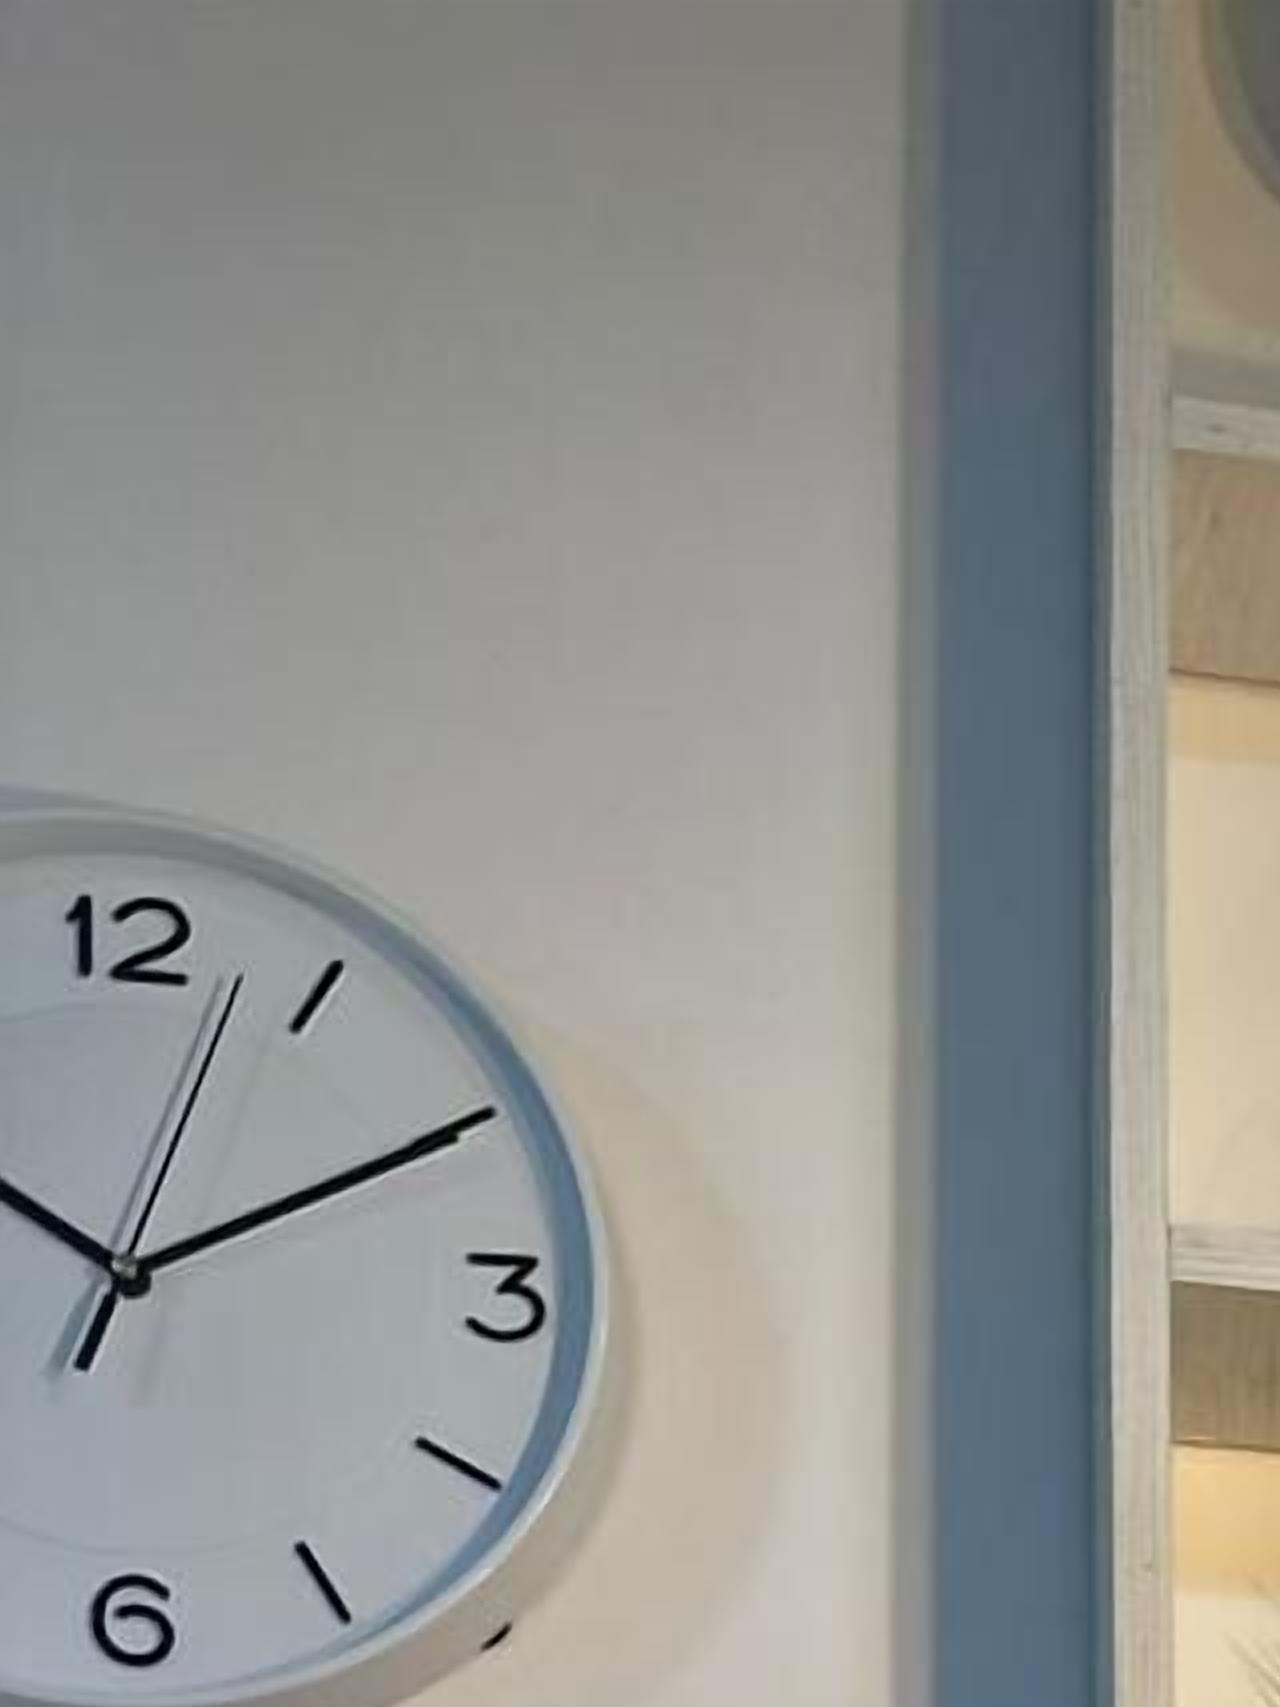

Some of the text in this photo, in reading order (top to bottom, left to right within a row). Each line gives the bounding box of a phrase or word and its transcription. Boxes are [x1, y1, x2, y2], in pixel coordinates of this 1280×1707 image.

[66, 894, 192, 985] 12
[465, 1251, 546, 1341] 3
[91, 1574, 175, 1668] 6
